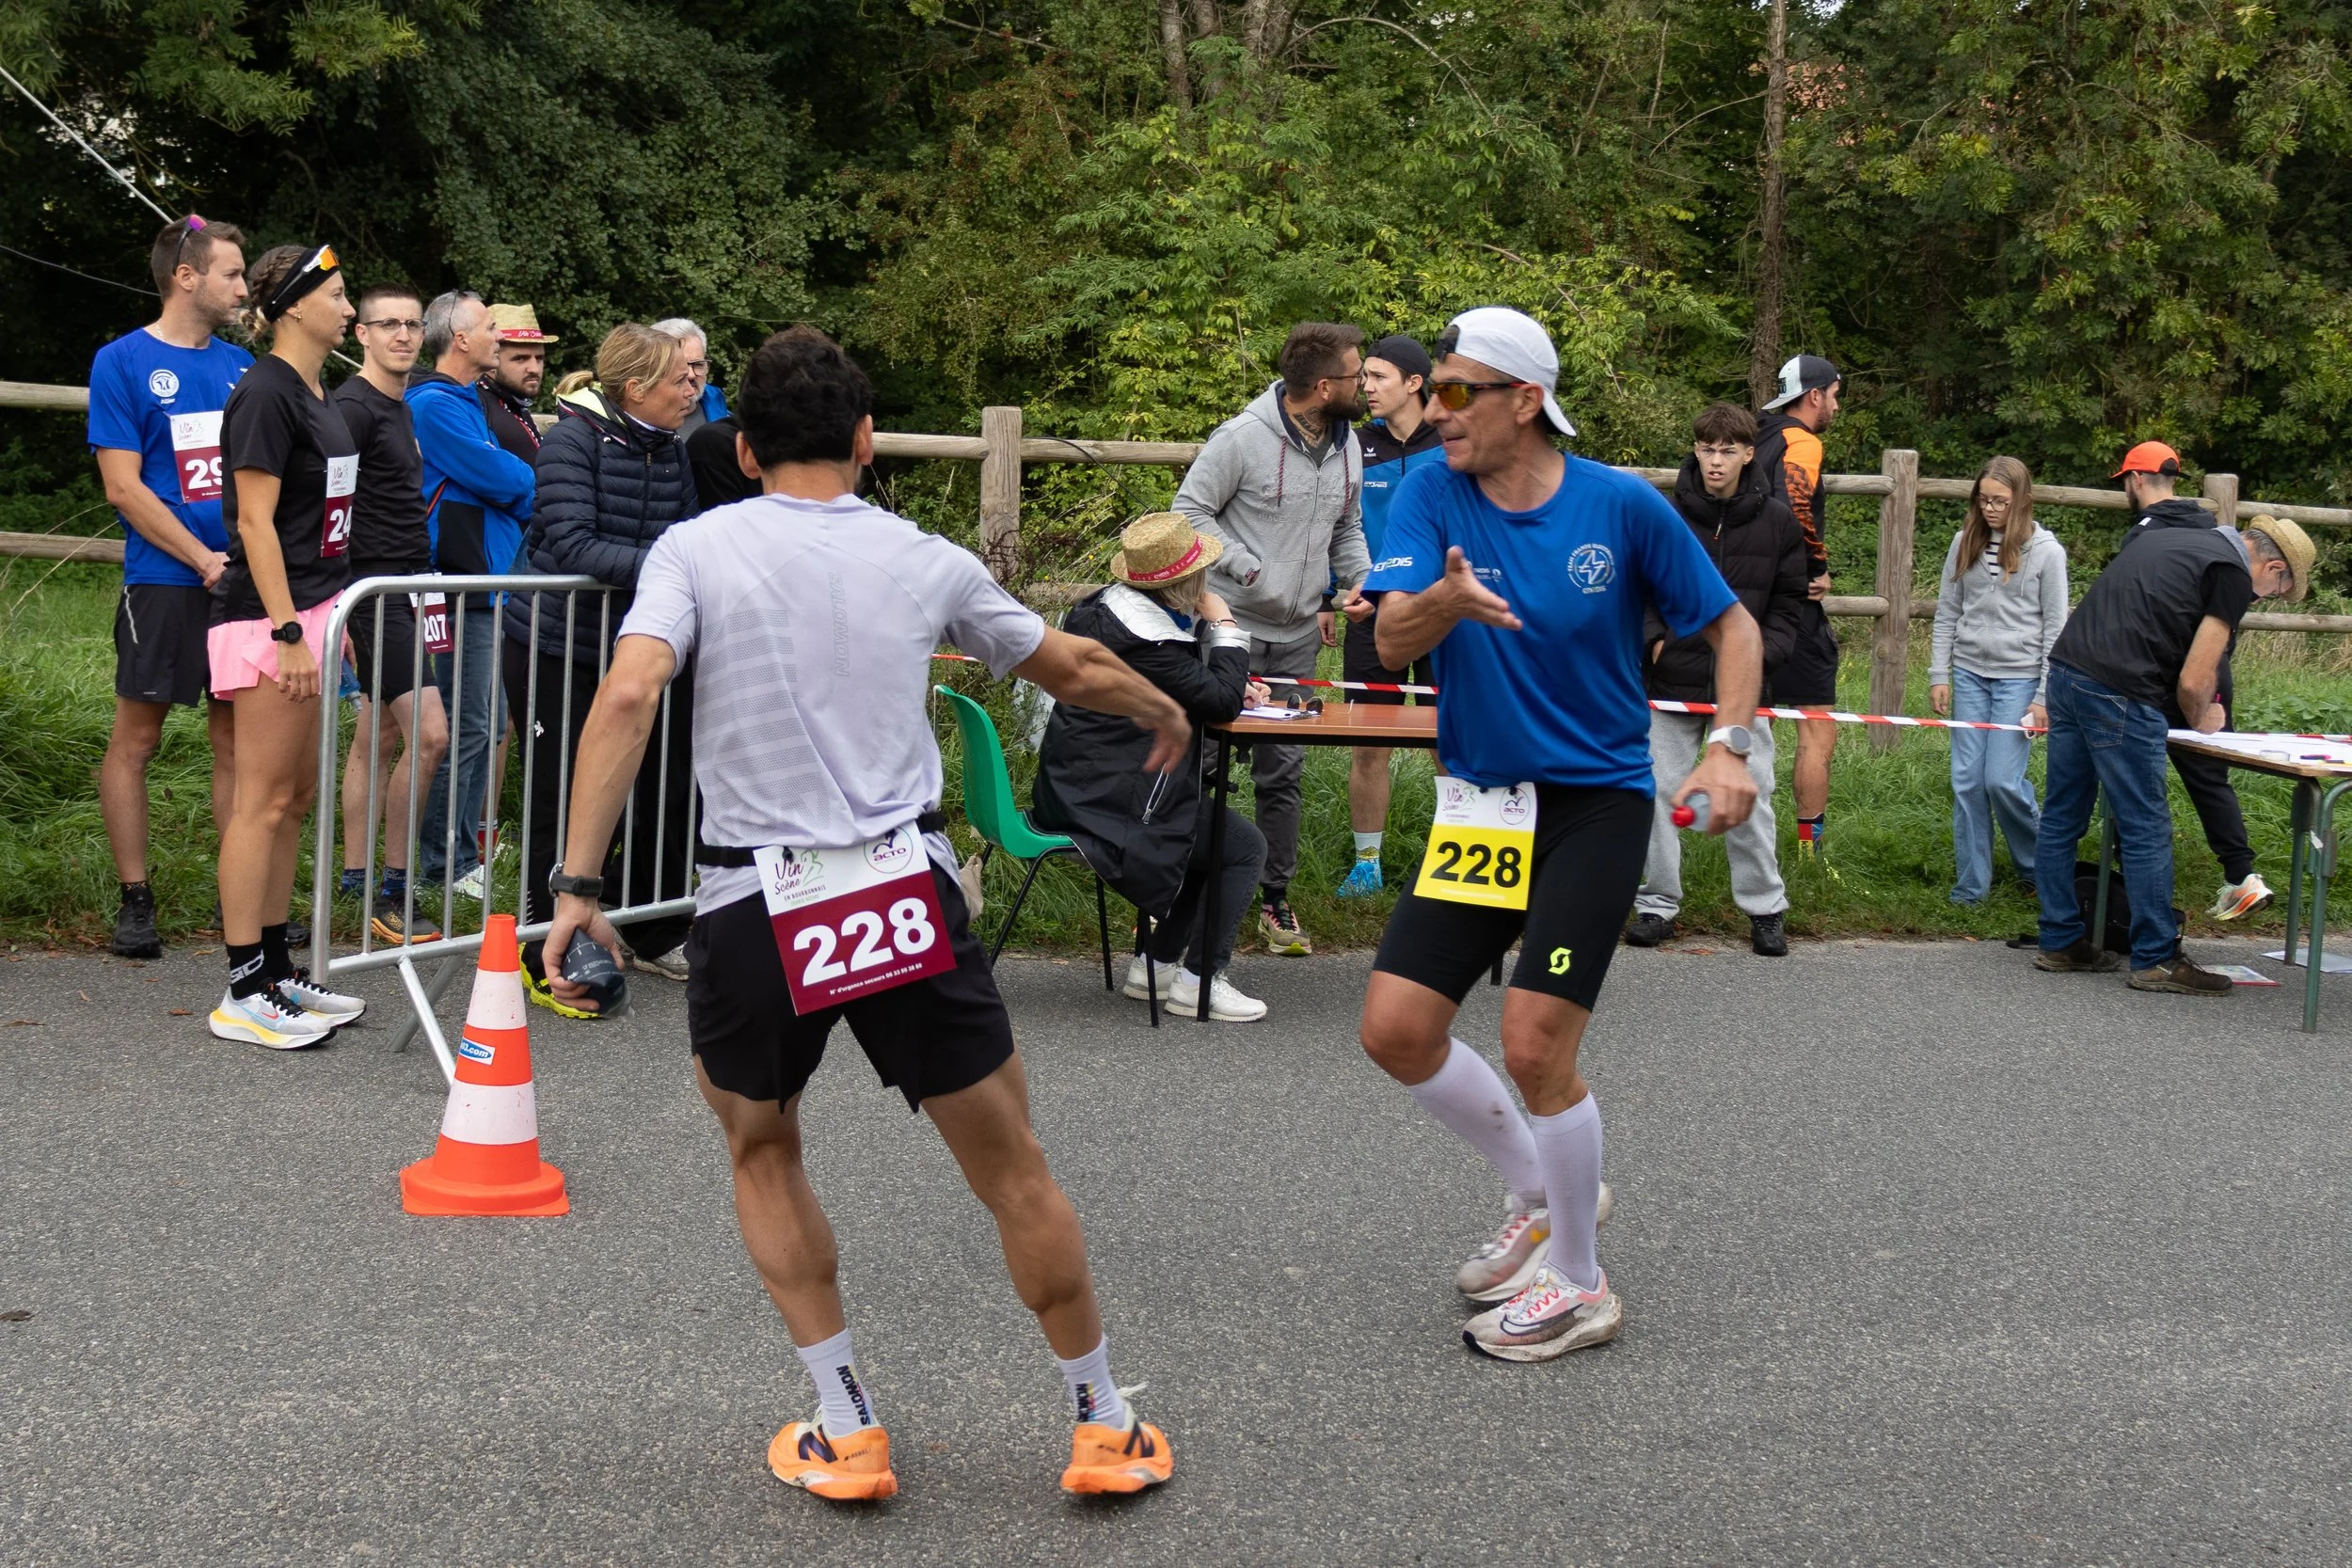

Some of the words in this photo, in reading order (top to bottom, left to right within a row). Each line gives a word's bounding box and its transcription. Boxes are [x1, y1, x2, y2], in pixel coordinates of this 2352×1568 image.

[828, 571, 850, 677] SALOMON
[1430, 841, 1521, 888] 228
[793, 897, 936, 987] 228
[864, 974, 885, 985] secours
[835, 1365, 871, 1426] SALOMON
